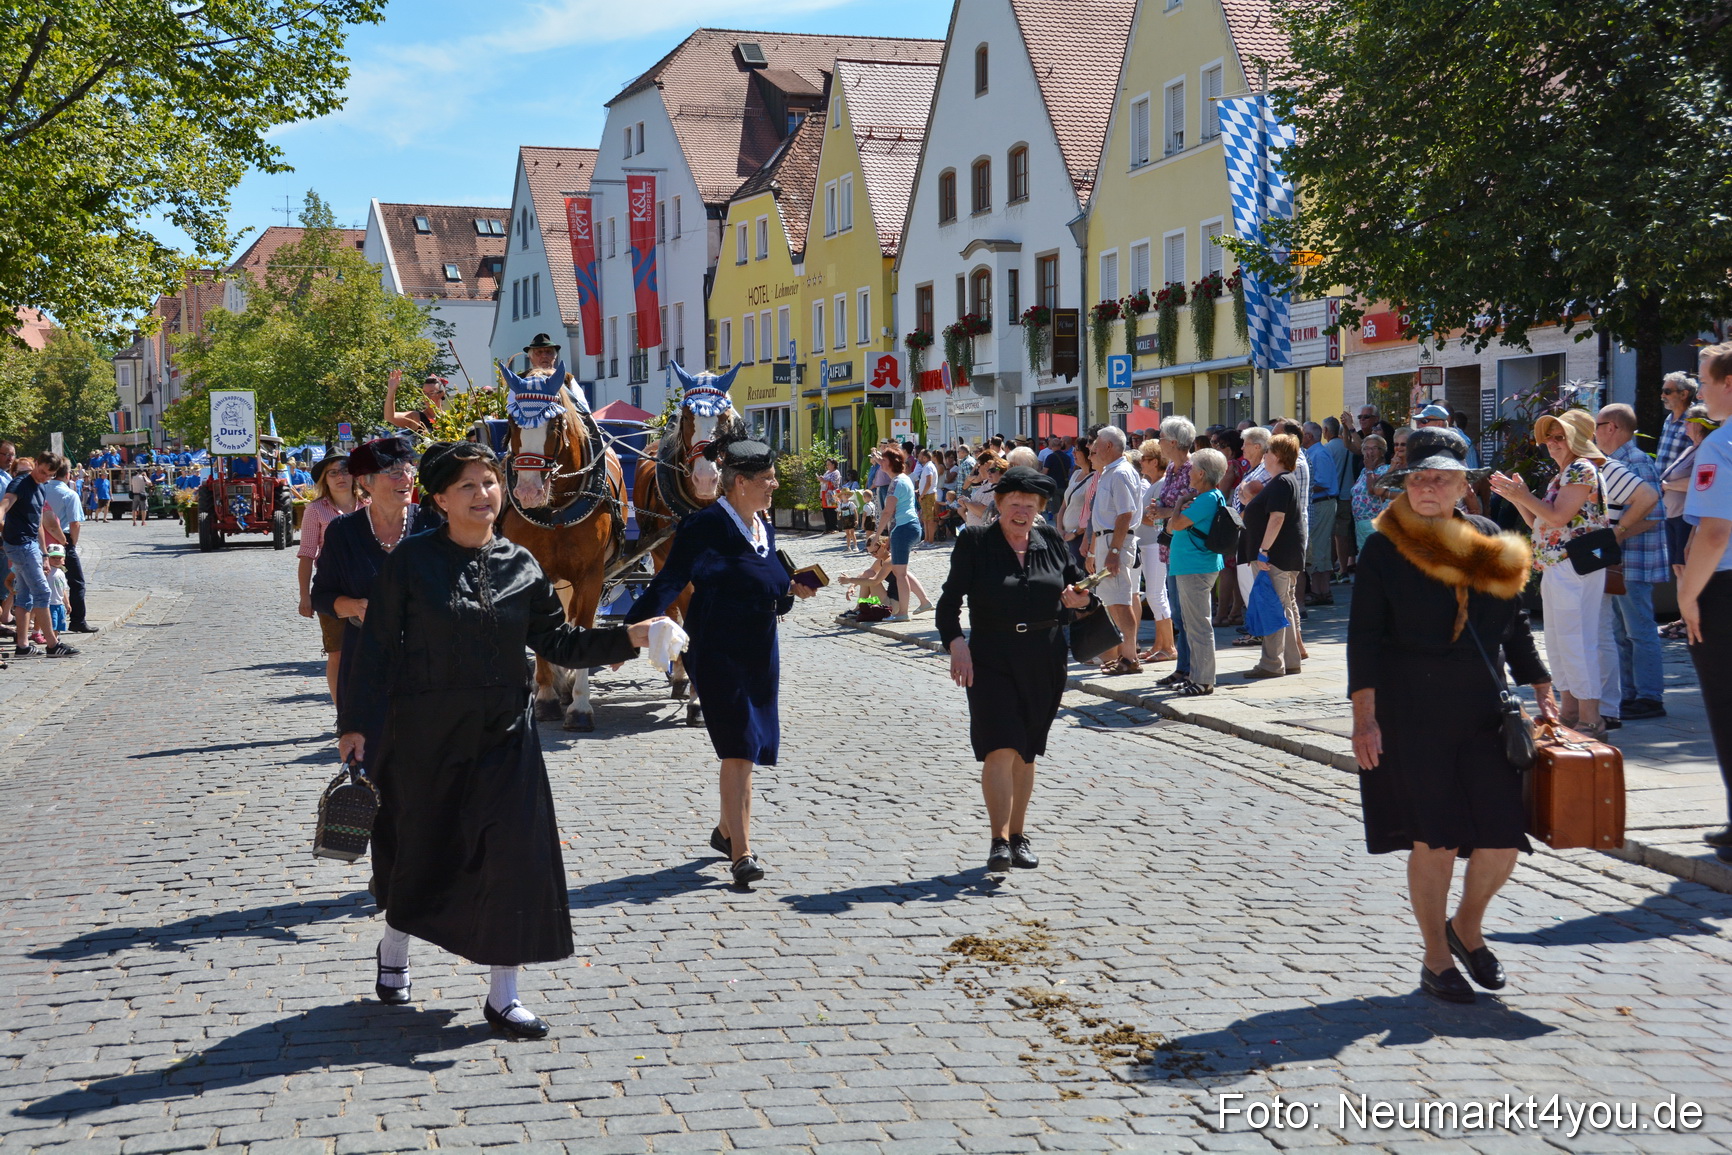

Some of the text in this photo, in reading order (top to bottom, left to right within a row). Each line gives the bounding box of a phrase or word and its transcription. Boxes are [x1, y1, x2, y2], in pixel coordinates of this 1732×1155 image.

[632, 181, 646, 222] K&L
[748, 280, 799, 306] HOTEL Lehmeier
[1303, 326, 1318, 340] KINO
[1329, 300, 1338, 360] KINO
[1113, 359, 1127, 385] P
[747, 386, 777, 401] Restaurant
[213, 433, 253, 450] Thannhausen
[220, 427, 247, 436] Durst
